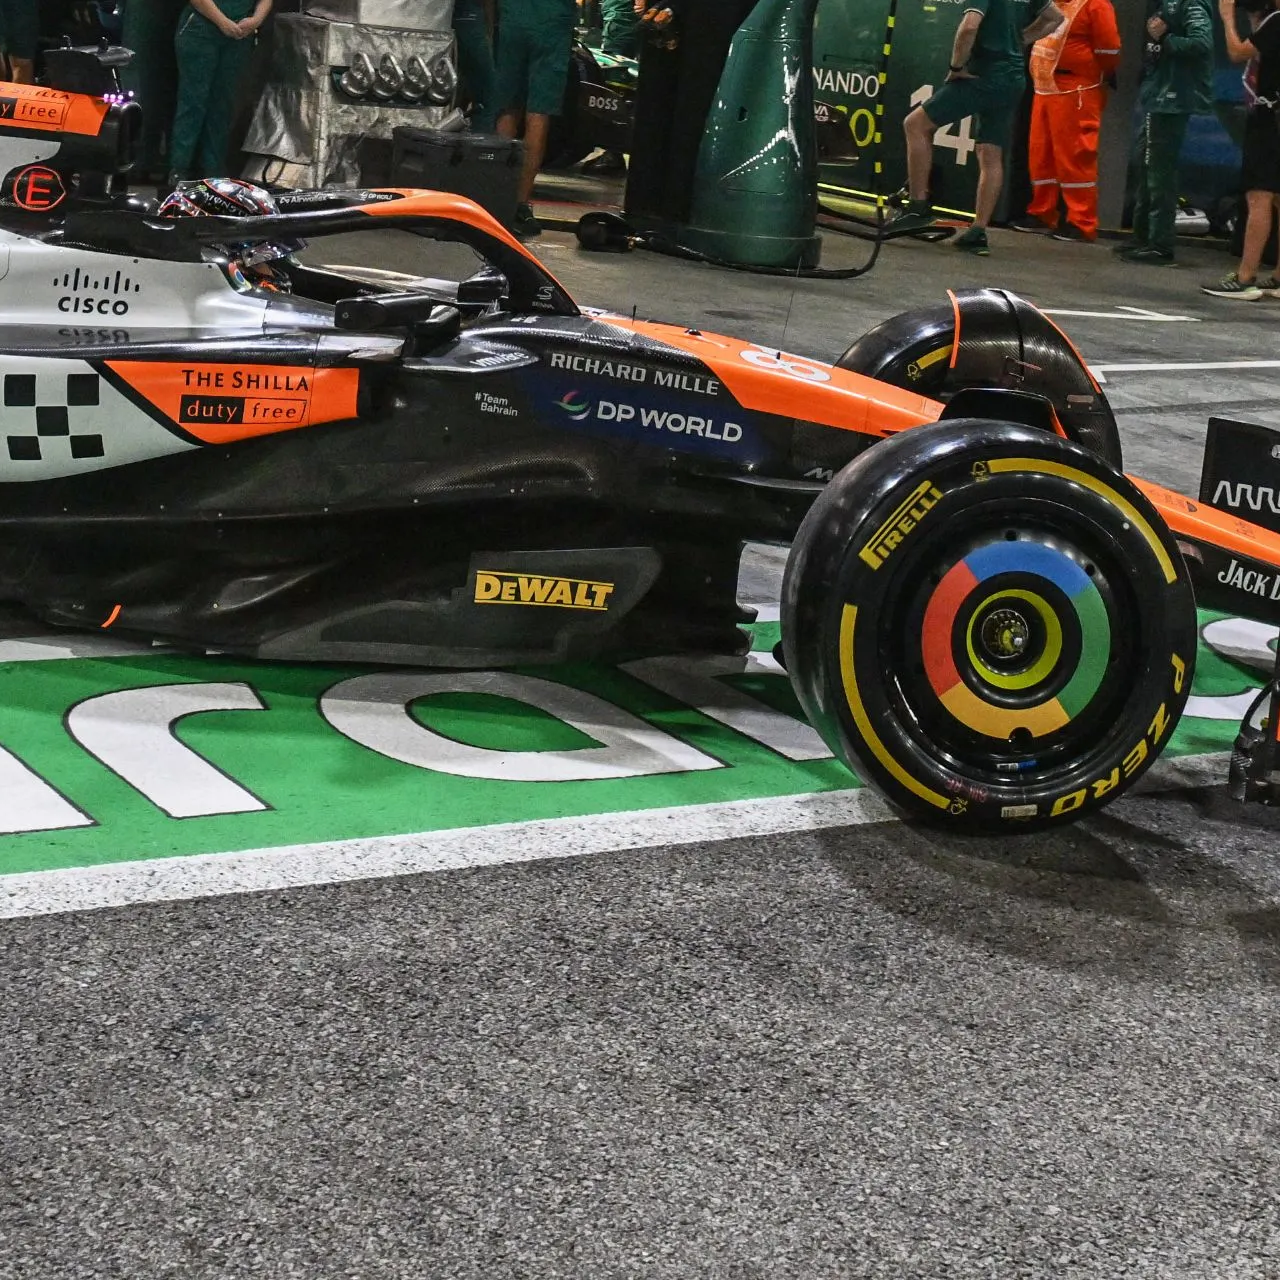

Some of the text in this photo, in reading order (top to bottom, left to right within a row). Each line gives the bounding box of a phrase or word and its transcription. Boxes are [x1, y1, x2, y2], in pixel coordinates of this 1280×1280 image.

[22, 102, 58, 119] free
[588, 94, 619, 111] BOSS
[25, 172, 54, 205] E
[58, 296, 129, 316] CISCO
[181, 368, 310, 392] THE SHILLA
[550, 352, 721, 396] RICHARD MILLE
[475, 391, 509, 406] #Team
[480, 402, 519, 418] Bahrain
[186, 400, 298, 424] duty free
[596, 400, 744, 444] DP WORLD
[857, 480, 943, 571] PIRELLI
[1217, 558, 1268, 597] JACK
[1049, 702, 1171, 817] ZERO
